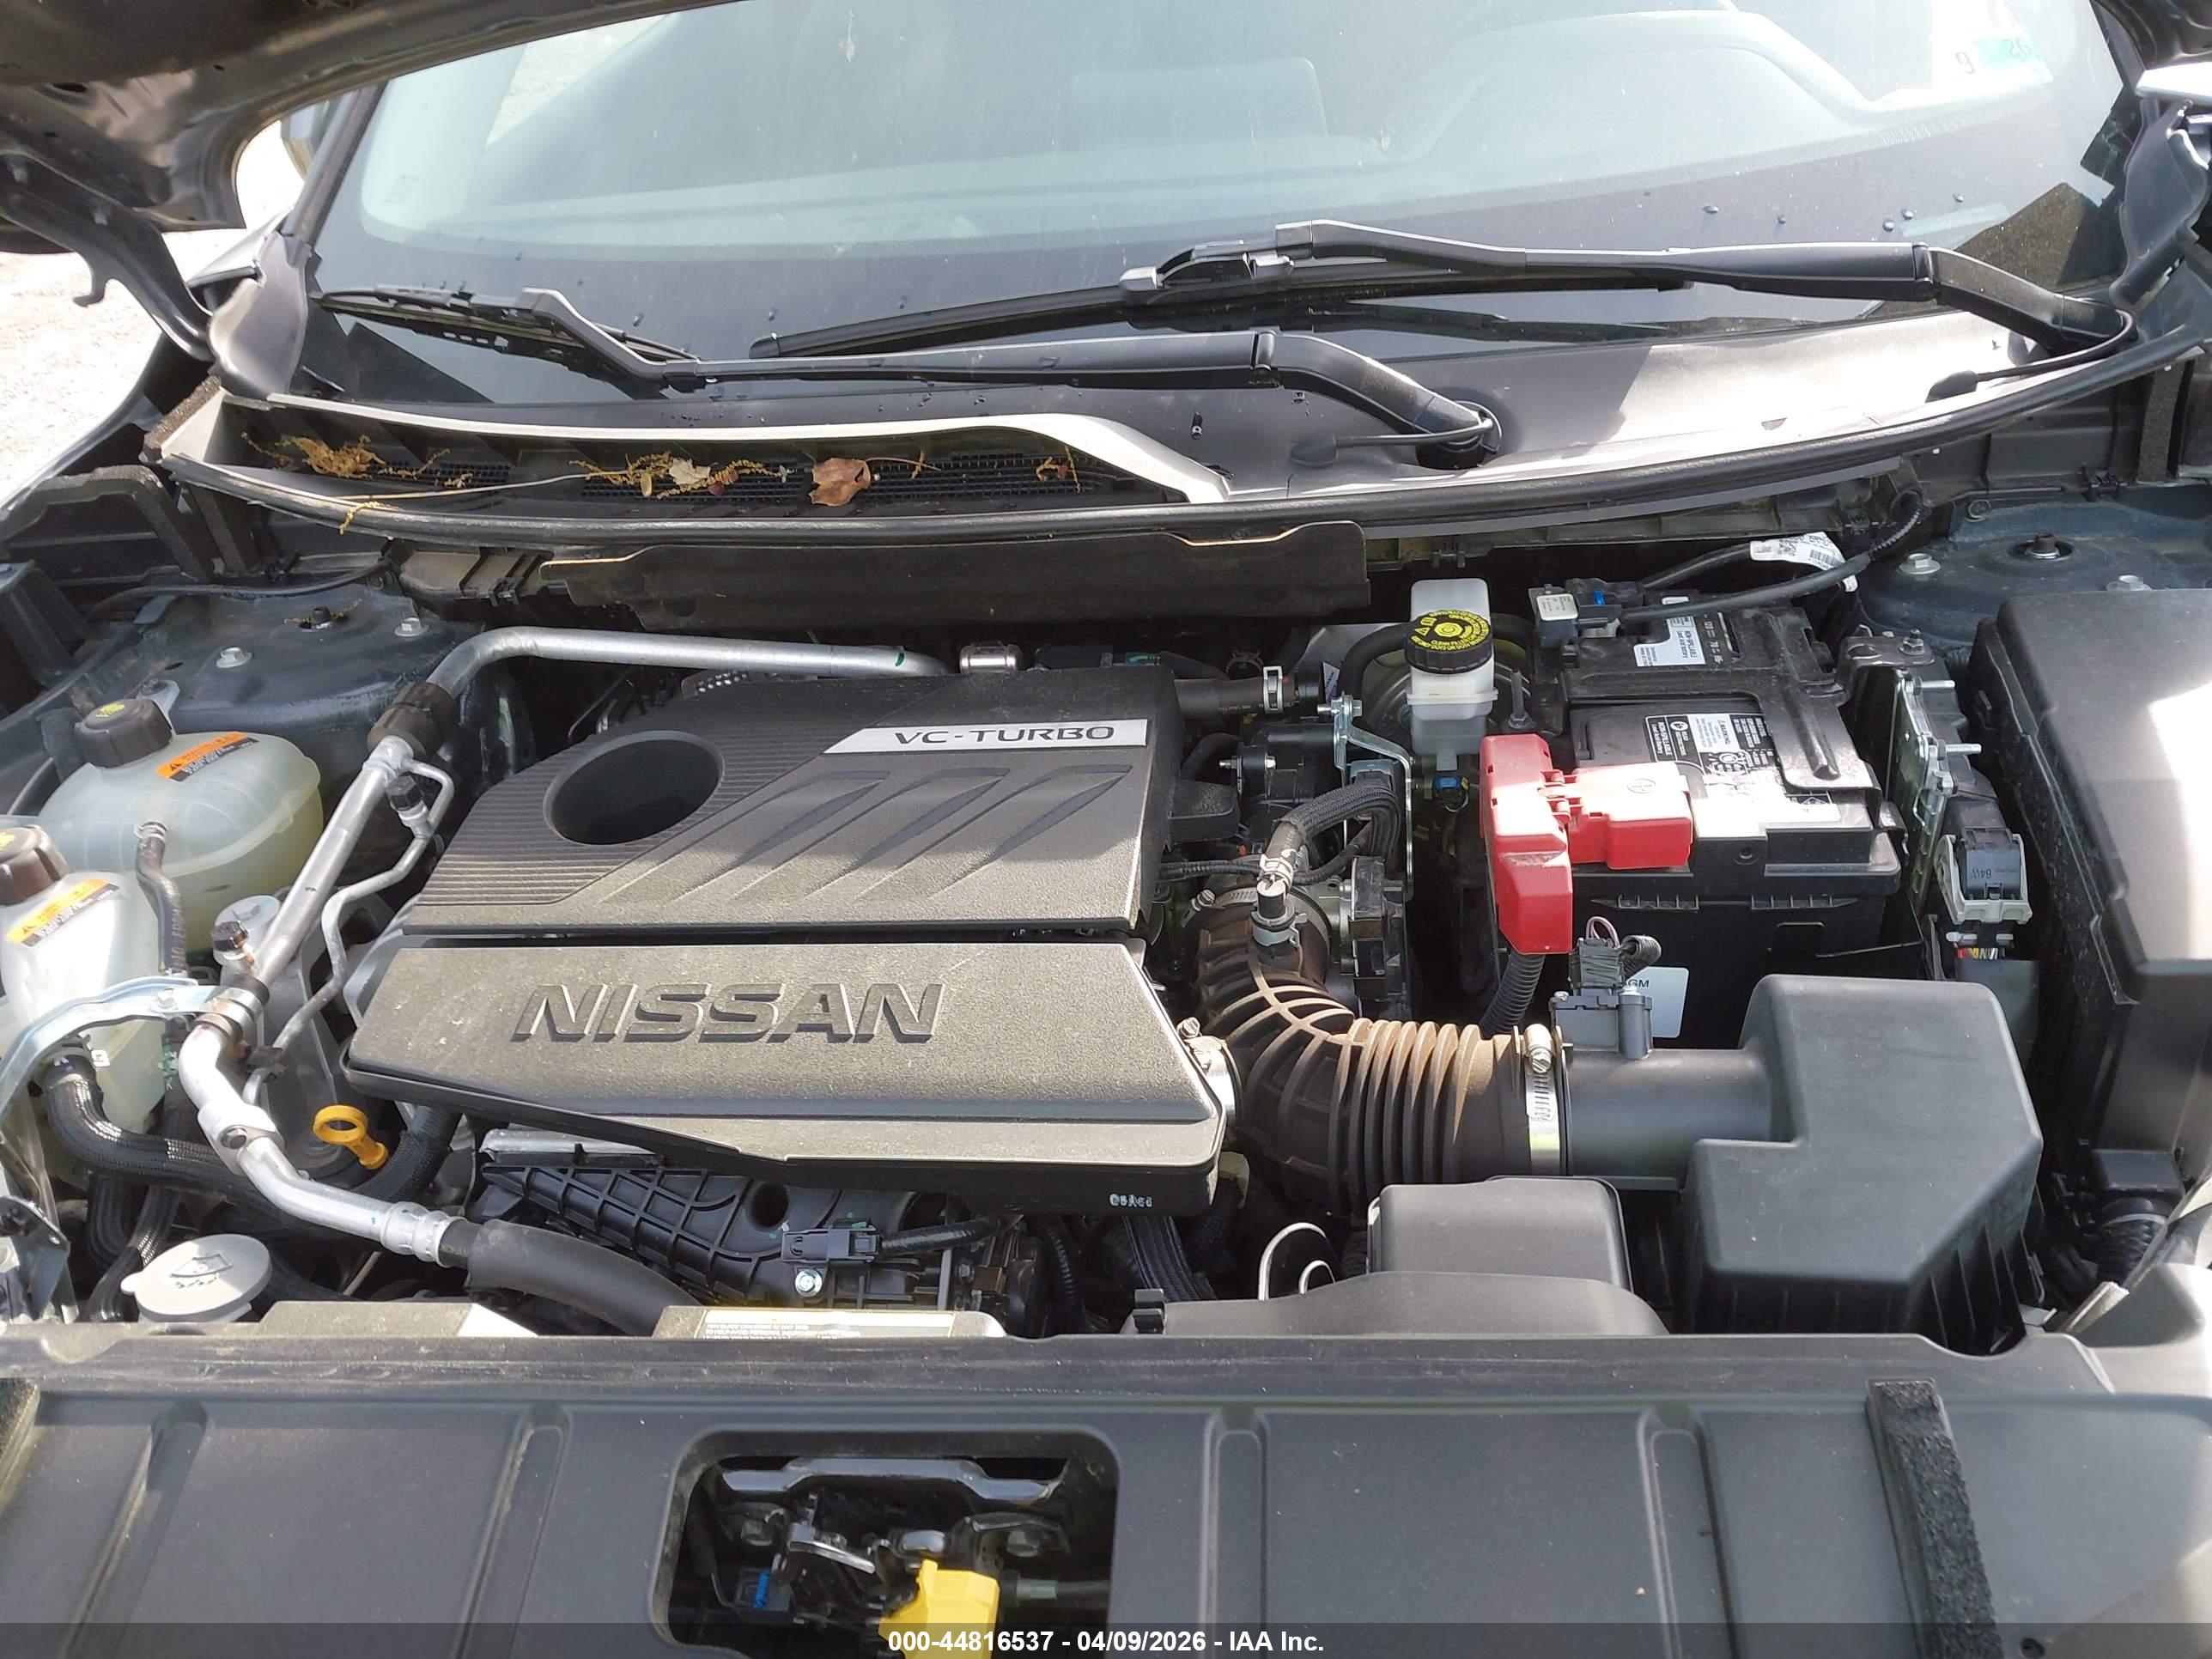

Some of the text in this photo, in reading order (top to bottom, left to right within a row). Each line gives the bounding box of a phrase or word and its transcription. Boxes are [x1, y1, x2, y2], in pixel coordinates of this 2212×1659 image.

[895, 726, 1115, 744] VC-TURBO
[1624, 979, 1650, 988] GM
[510, 982, 945, 1043] NISSAN
